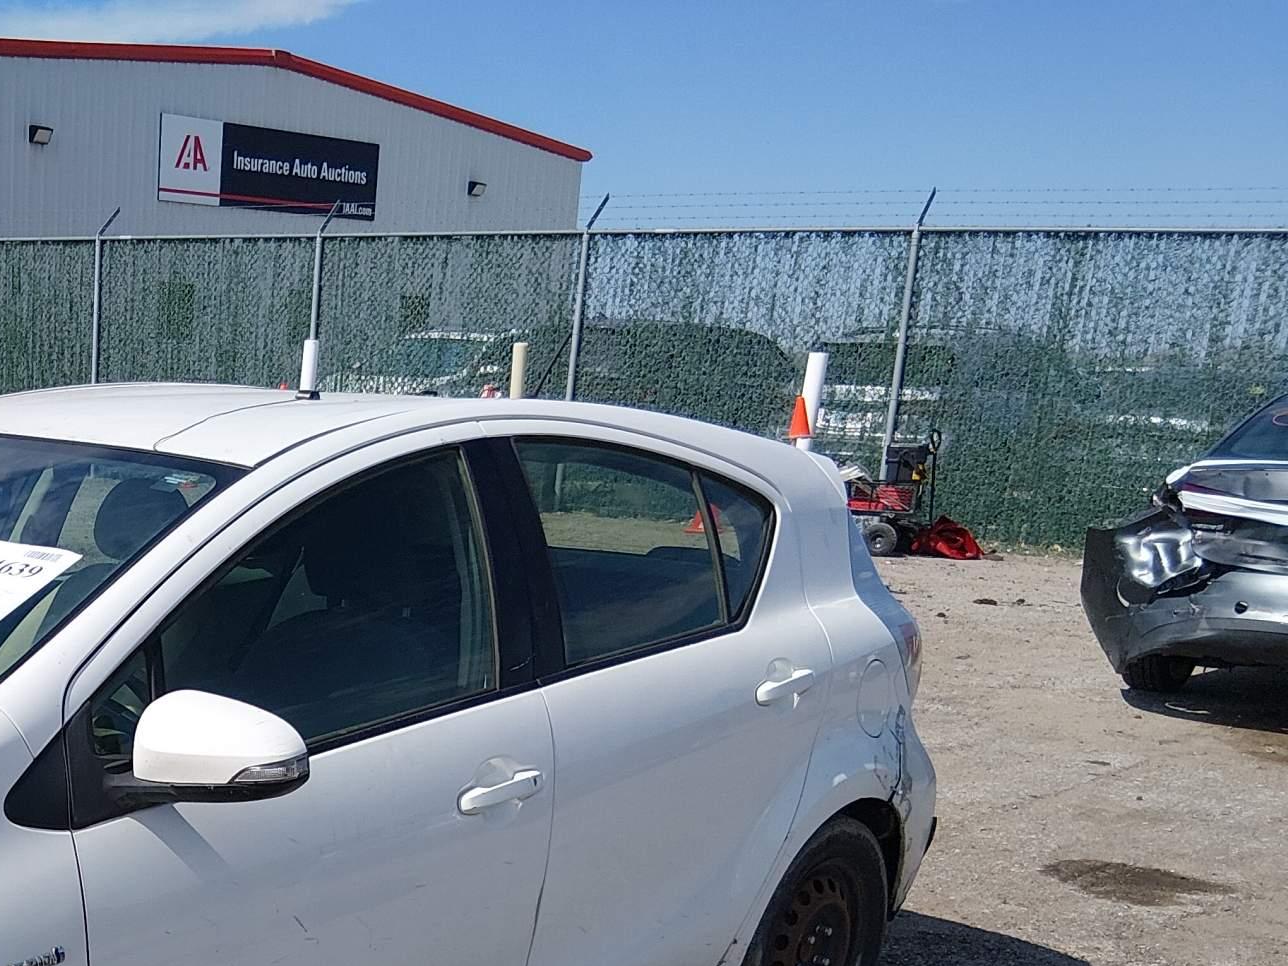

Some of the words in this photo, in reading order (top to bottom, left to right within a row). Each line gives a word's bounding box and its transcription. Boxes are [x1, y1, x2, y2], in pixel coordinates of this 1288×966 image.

[233, 150, 290, 176] Insurance
[292, 158, 318, 179] Auto
[319, 161, 367, 185] Auctions
